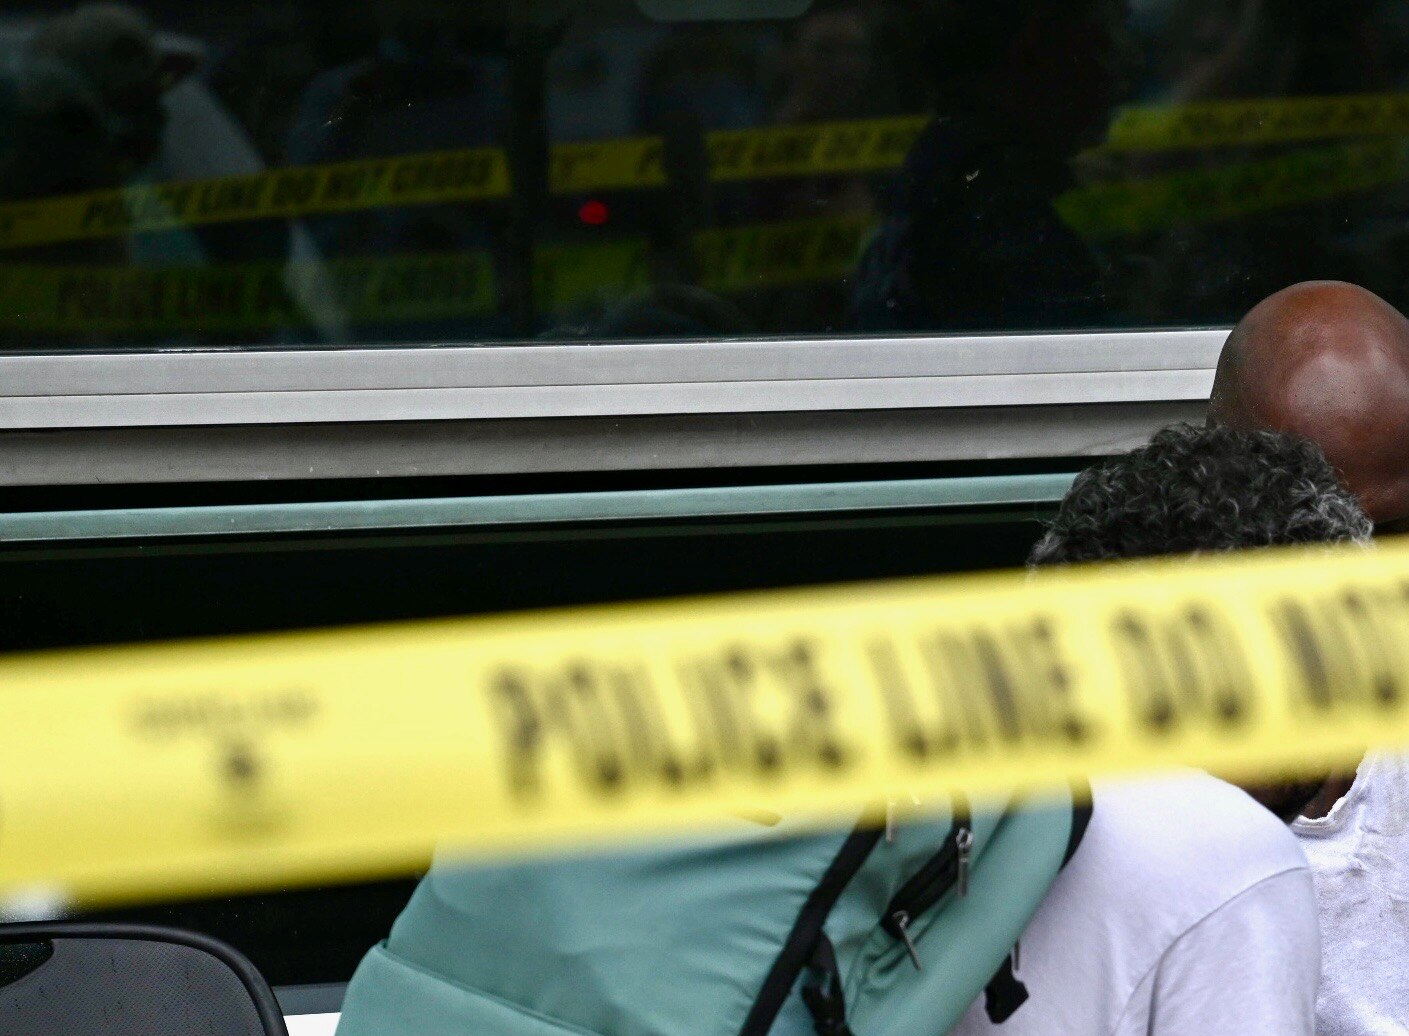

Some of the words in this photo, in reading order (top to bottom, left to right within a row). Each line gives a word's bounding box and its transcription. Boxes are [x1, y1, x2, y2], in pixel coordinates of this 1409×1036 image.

[488, 633, 852, 805] POLICE
[866, 612, 1094, 764] LINE
[1110, 604, 1260, 738] DO
